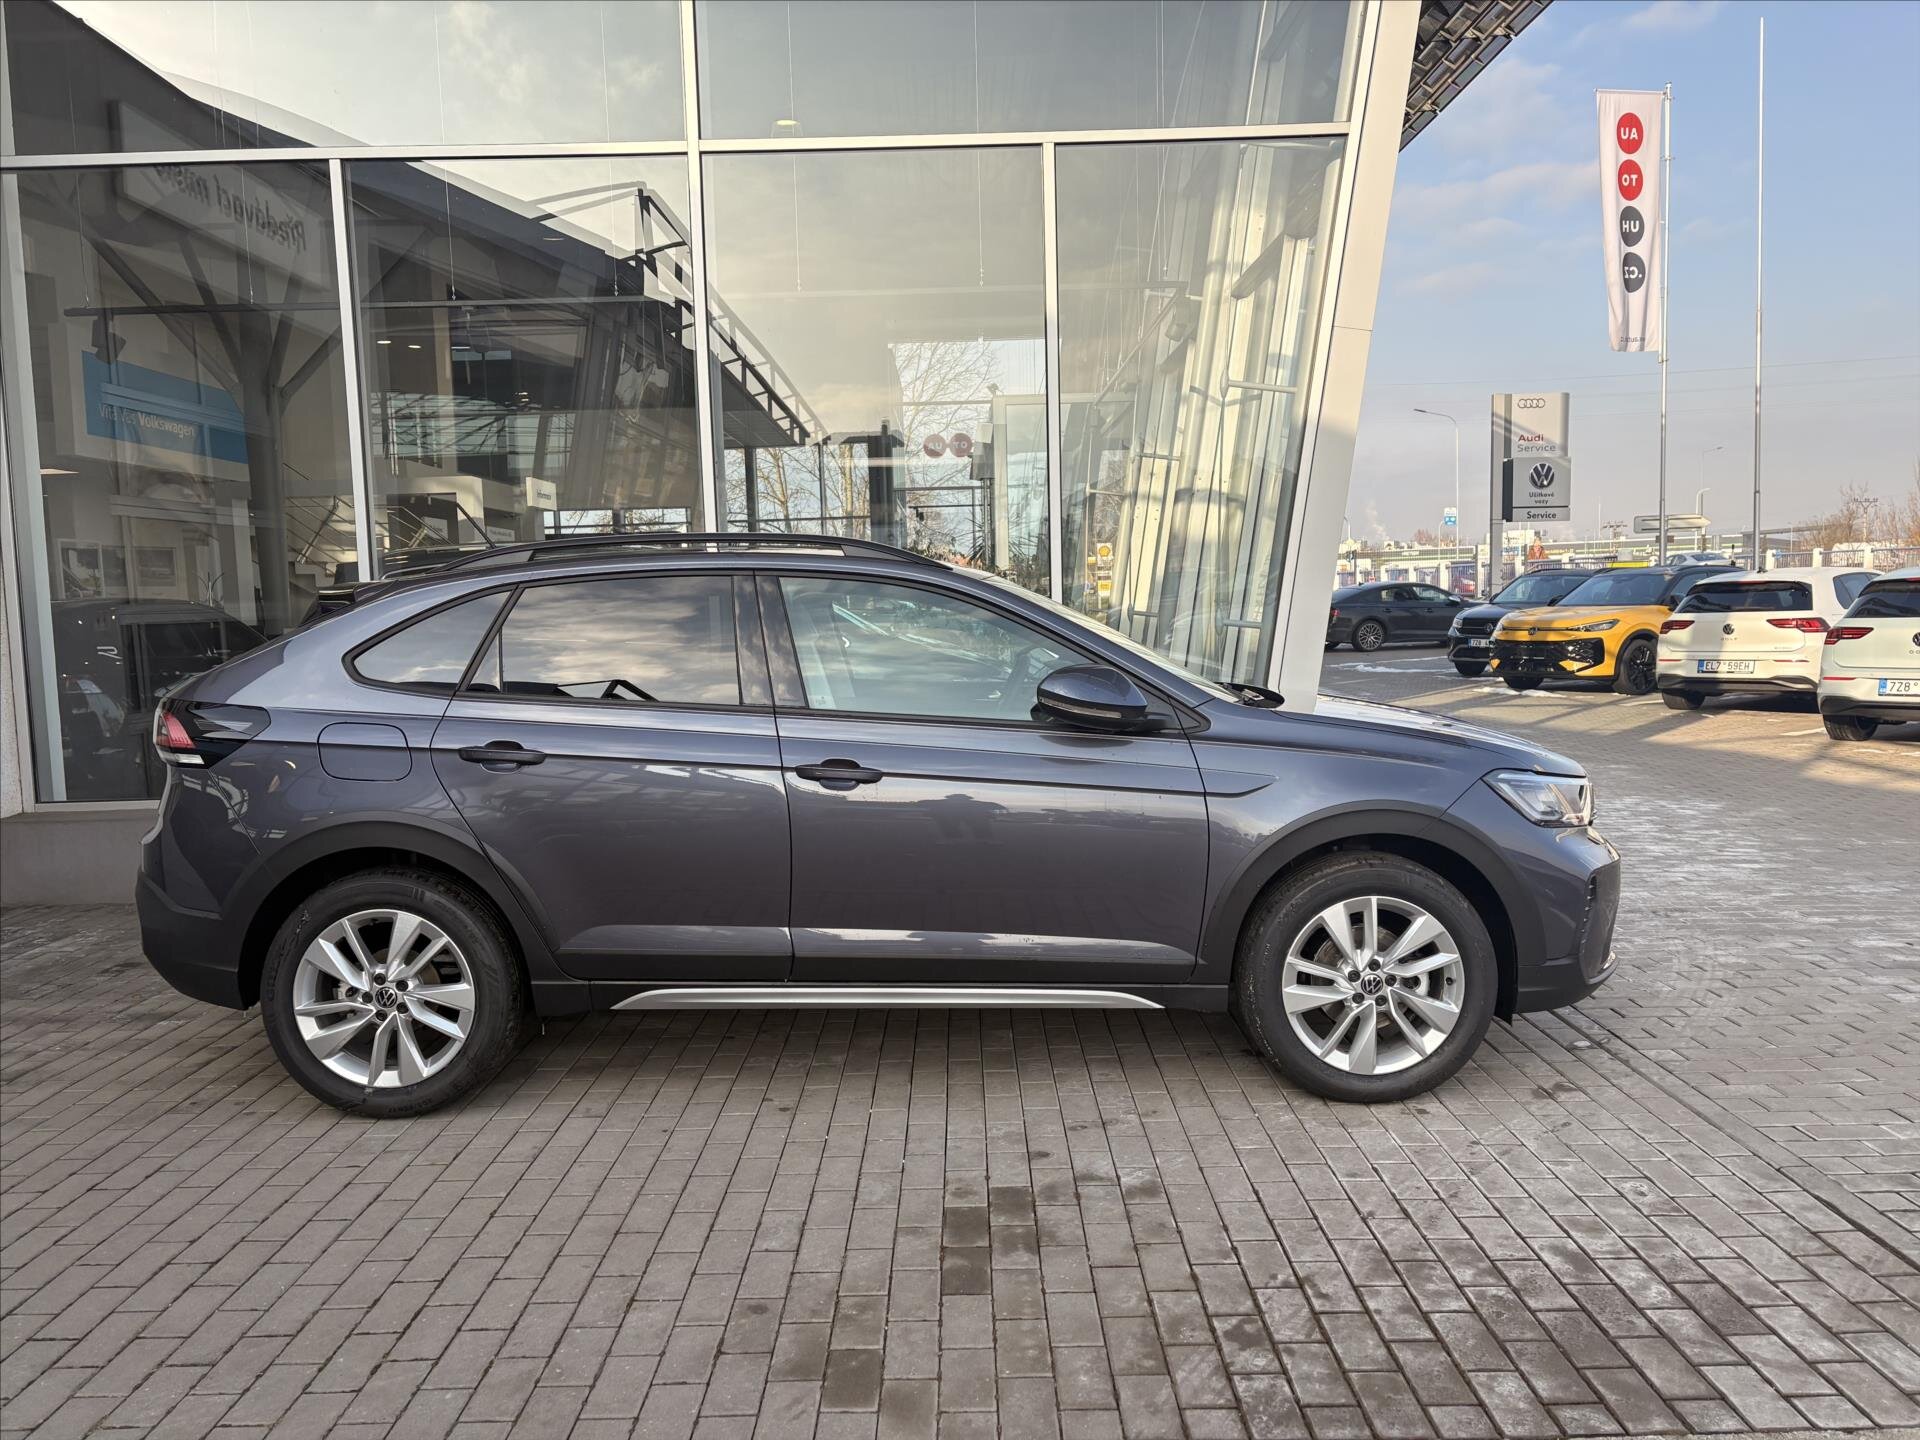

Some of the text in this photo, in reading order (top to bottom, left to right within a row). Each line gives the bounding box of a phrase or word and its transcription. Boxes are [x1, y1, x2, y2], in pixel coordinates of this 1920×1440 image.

[138, 411, 194, 439] Volkswagen
[1518, 433, 1544, 442] Audi
[1517, 443, 1556, 453] Service
[1526, 510, 1557, 519] Service
[1705, 661, 1721, 671] EL7
[1889, 681, 1911, 692] 7Z8
